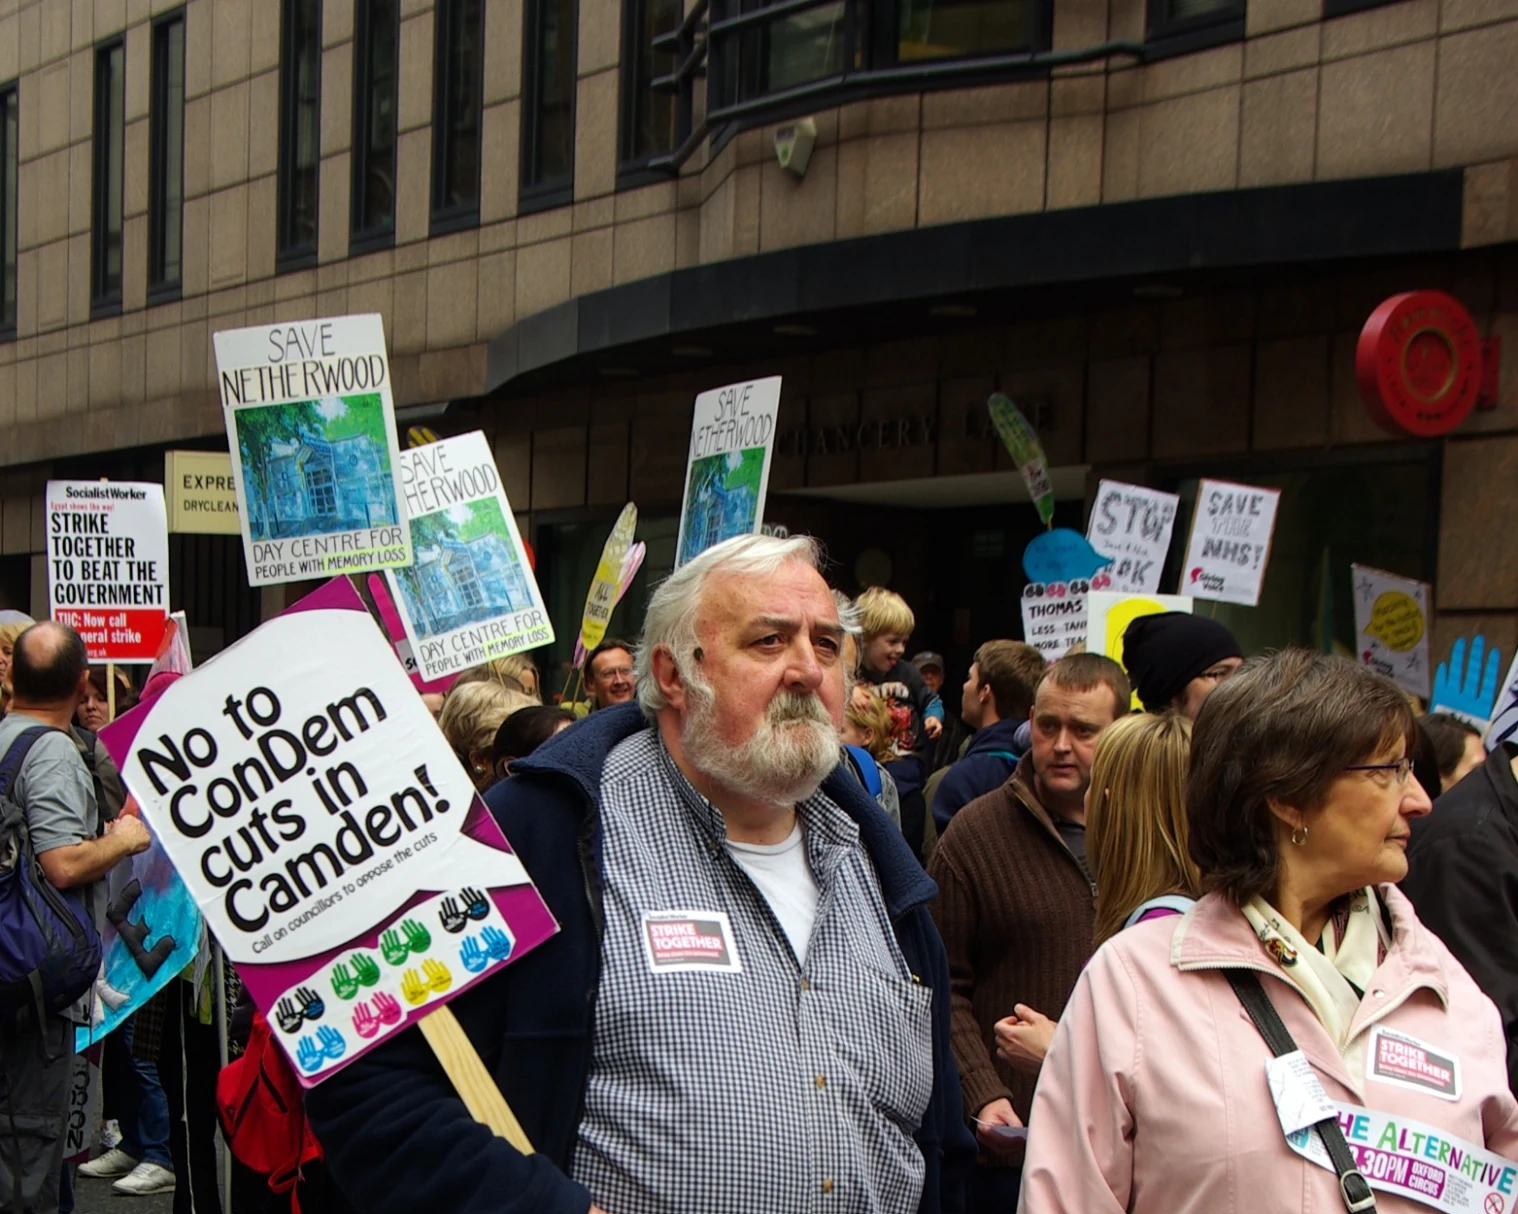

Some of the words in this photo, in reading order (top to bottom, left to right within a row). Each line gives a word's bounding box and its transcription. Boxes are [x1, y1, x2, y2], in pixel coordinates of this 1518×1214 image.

[268, 323, 335, 363] SAVE
[222, 354, 385, 406] NETHERWOOD
[714, 384, 754, 422] SAVE
[183, 474, 236, 491] EXPRE
[404, 463, 498, 516] HERWOOD
[183, 499, 239, 513] DRYCLEAN
[1097, 490, 1174, 543] STOP
[1208, 490, 1264, 516] SAVE
[51, 513, 109, 534] STRIKE
[52, 536, 135, 558] TOGETHER
[253, 541, 284, 564] DAY
[291, 532, 366, 558] CENTRE
[370, 527, 404, 548] FOR
[53, 560, 74, 581] TO
[81, 560, 120, 582] BEAT
[126, 561, 157, 582] THE
[255, 562, 297, 579] PEOPLE
[299, 559, 325, 574] WITH
[327, 551, 375, 570] MEMORY
[377, 547, 407, 564] LOSS
[55, 583, 164, 605] GOVERNMENT
[57, 612, 82, 628] TUC:
[84, 613, 105, 627] Now
[109, 613, 127, 628] call
[1028, 599, 1083, 619] THOMAS
[80, 630, 108, 644] neral
[111, 629, 141, 644] strike
[419, 640, 445, 662] DAY
[451, 620, 512, 652] CENTRE
[515, 610, 545, 633] FOR
[1031, 624, 1056, 636] LESS
[425, 656, 462, 676] PEOPLE
[462, 646, 487, 663] WITH
[487, 635, 526, 656] MEMORY
[528, 627, 550, 643] LOSS
[137, 727, 218, 797] No
[222, 686, 282, 741] to
[169, 687, 388, 838] ConDem
[200, 798, 307, 888] cuts
[306, 761, 369, 816] in
[224, 763, 451, 933] Camden!
[252, 933, 274, 955] Call
[273, 924, 288, 941] on
[287, 890, 344, 932] councillors
[343, 881, 356, 898] to
[355, 856, 395, 890] oppose
[393, 846, 413, 865] the
[414, 831, 438, 853] cuts
[650, 924, 697, 937] STRIKE
[654, 936, 723, 950] TOGETHER
[1380, 1038, 1427, 1062] STRIKE
[1381, 1051, 1451, 1083] TOGETHER
[1336, 1111, 1371, 1141] HE
[1376, 1121, 1518, 1195] ALTERNATIVE
[1408, 1174, 1439, 1196] CIRCUS
[1411, 1161, 1444, 1184] OXFORD
